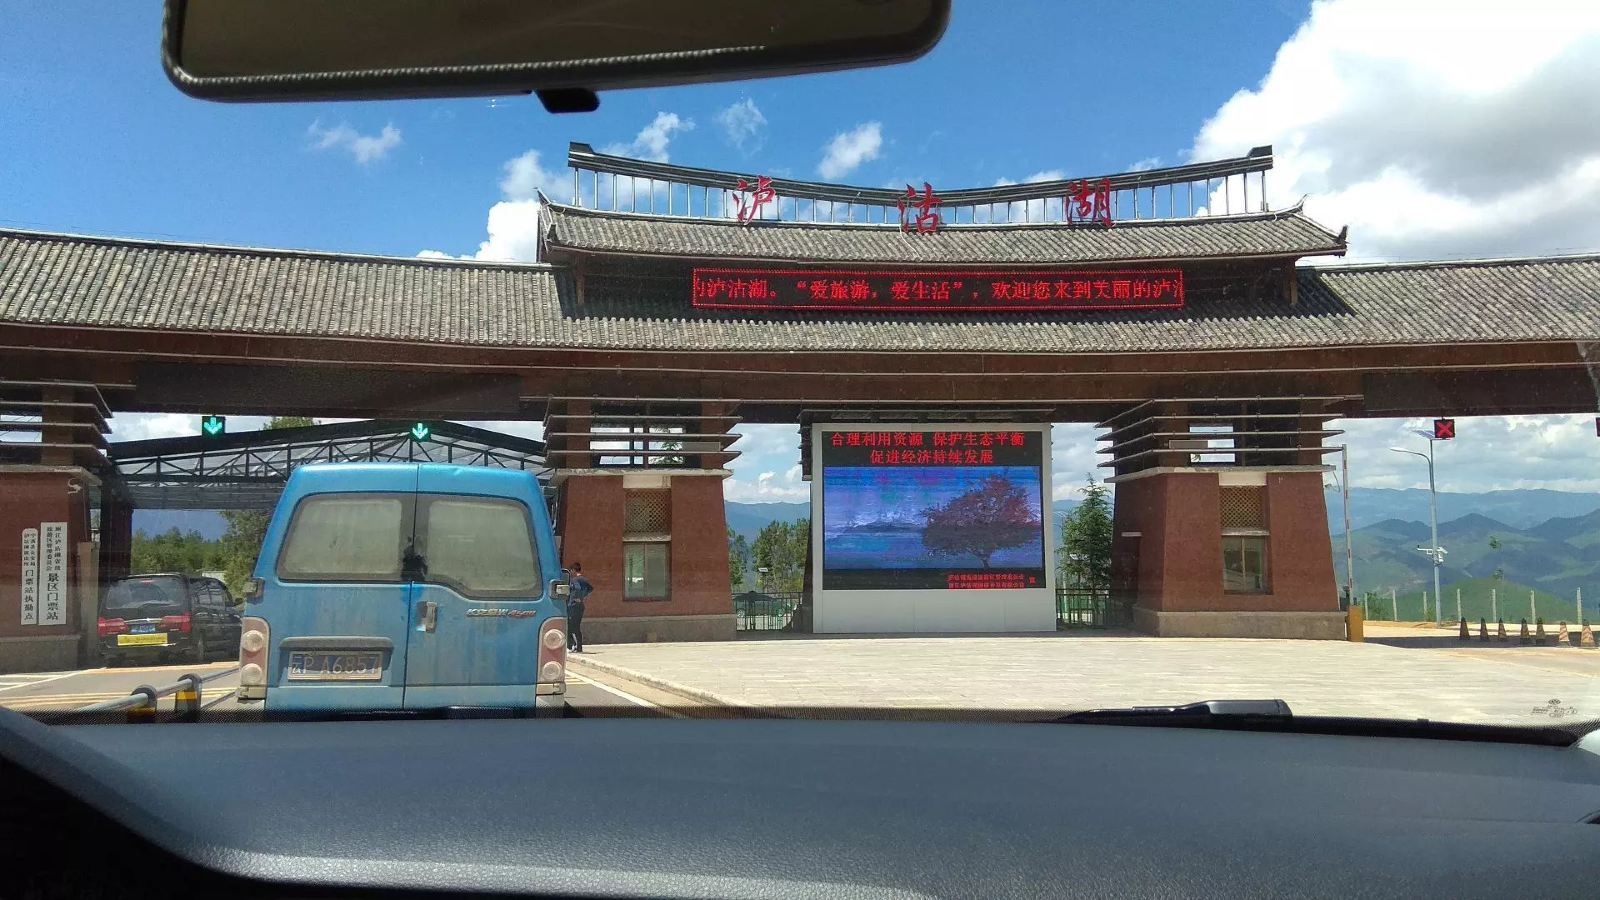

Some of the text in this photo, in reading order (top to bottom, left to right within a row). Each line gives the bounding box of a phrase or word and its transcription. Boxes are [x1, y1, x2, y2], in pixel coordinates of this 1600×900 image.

[732, 175, 1115, 234] 泸沽湖
[830, 431, 1025, 447] 合理利用资源 保护生态平衡
[869, 449, 994, 465] 促进经济持续发展
[46, 572, 59, 620] 景区门票站
